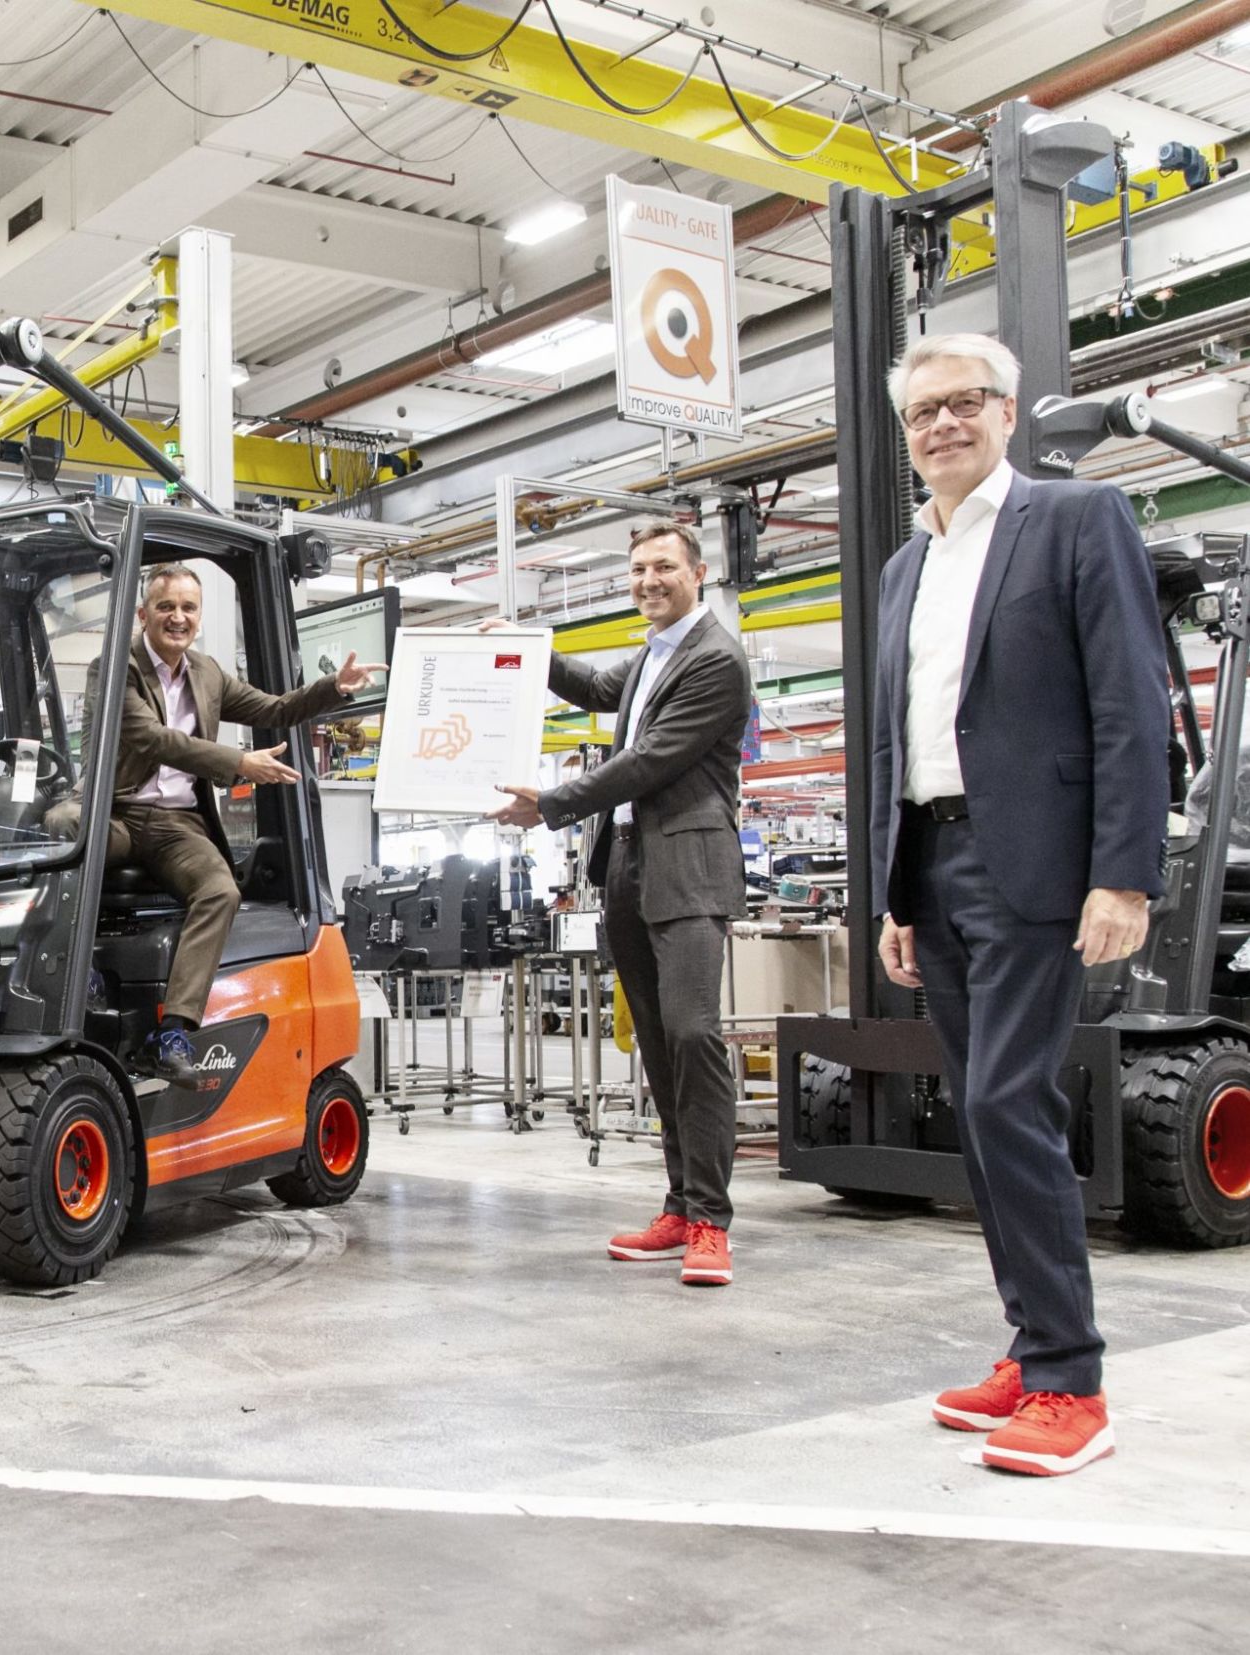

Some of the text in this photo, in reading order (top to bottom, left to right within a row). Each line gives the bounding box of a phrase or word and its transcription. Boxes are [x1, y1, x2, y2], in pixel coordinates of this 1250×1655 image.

[630, 203, 678, 229] UALITY
[687, 217, 718, 241] GATE
[684, 404, 733, 428] QUALITY
[417, 655, 437, 717] URKUNDE
[192, 1043, 237, 1071] Linde
